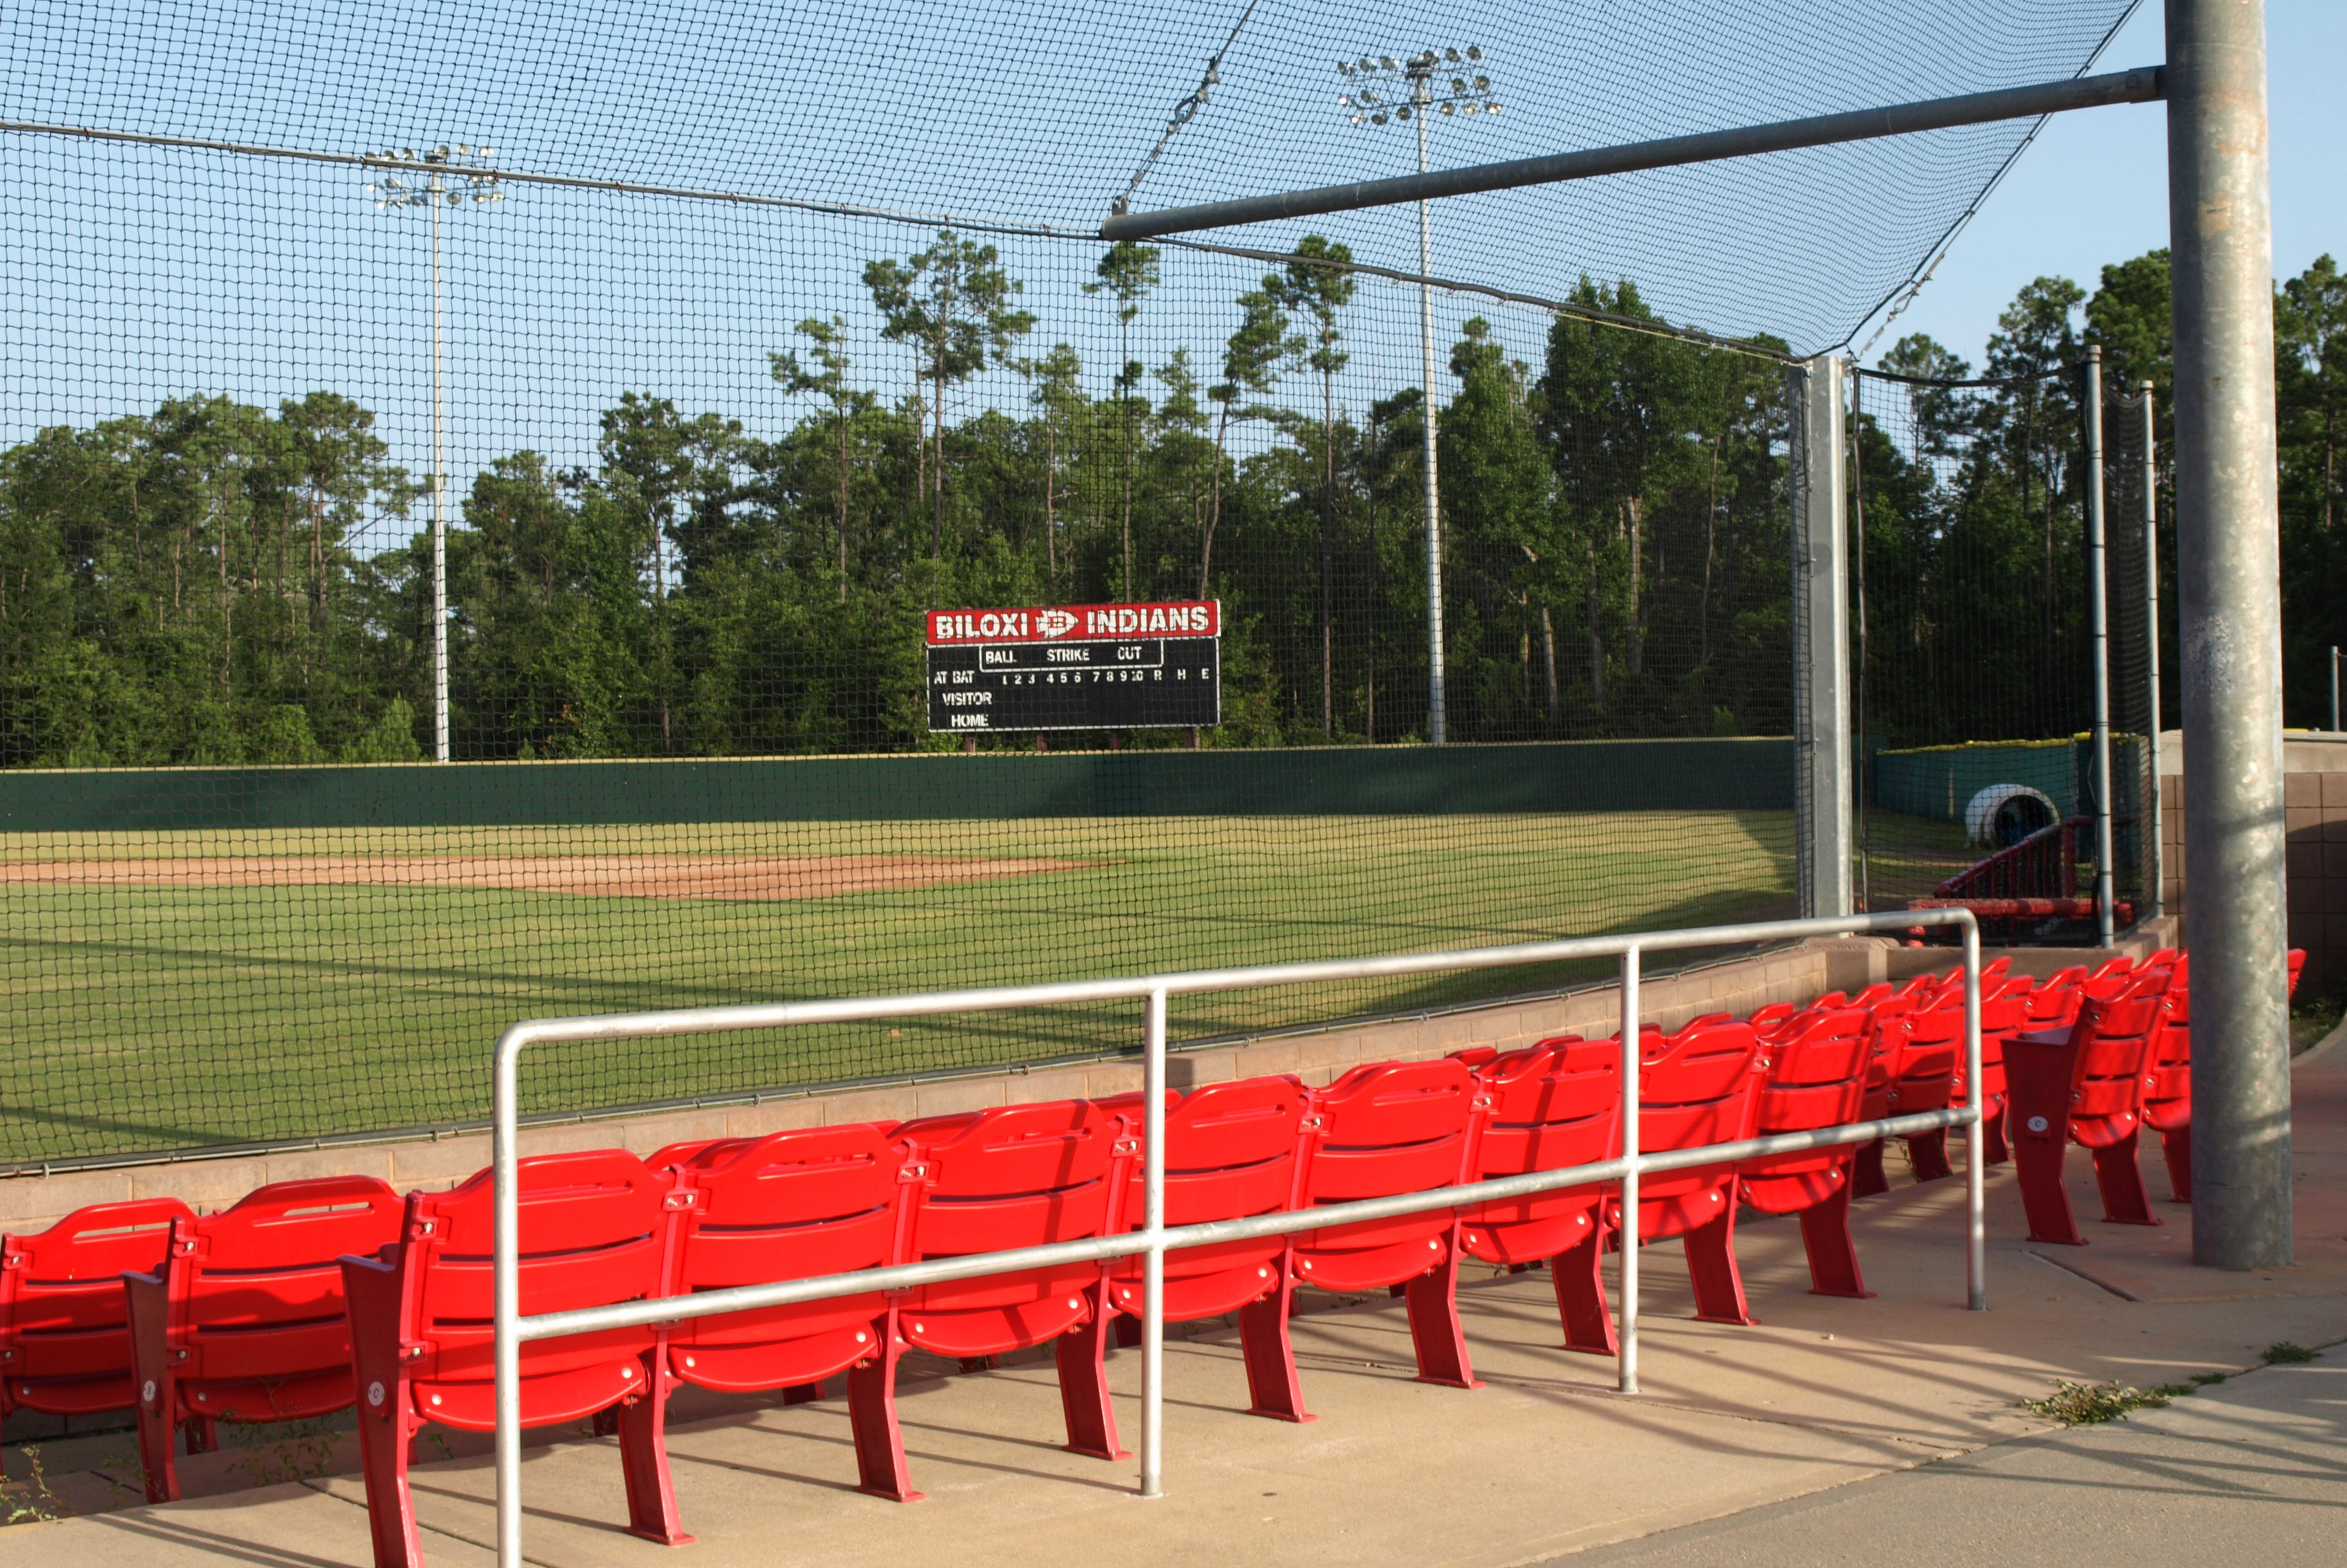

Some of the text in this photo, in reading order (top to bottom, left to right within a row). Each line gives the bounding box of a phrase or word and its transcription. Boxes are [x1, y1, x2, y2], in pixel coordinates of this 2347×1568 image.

[935, 613, 1028, 640] BILOXI
[1087, 606, 1210, 634] INDIANS
[985, 646, 1142, 664] BALL STRIKE OUT
[934, 668, 1209, 685] AT BAT 1 2 3 4 5 6 7 8 9 10 R H E
[942, 692, 993, 706] VISITOR
[951, 714, 989, 728] HOME
[373, 1388, 380, 1399] C
